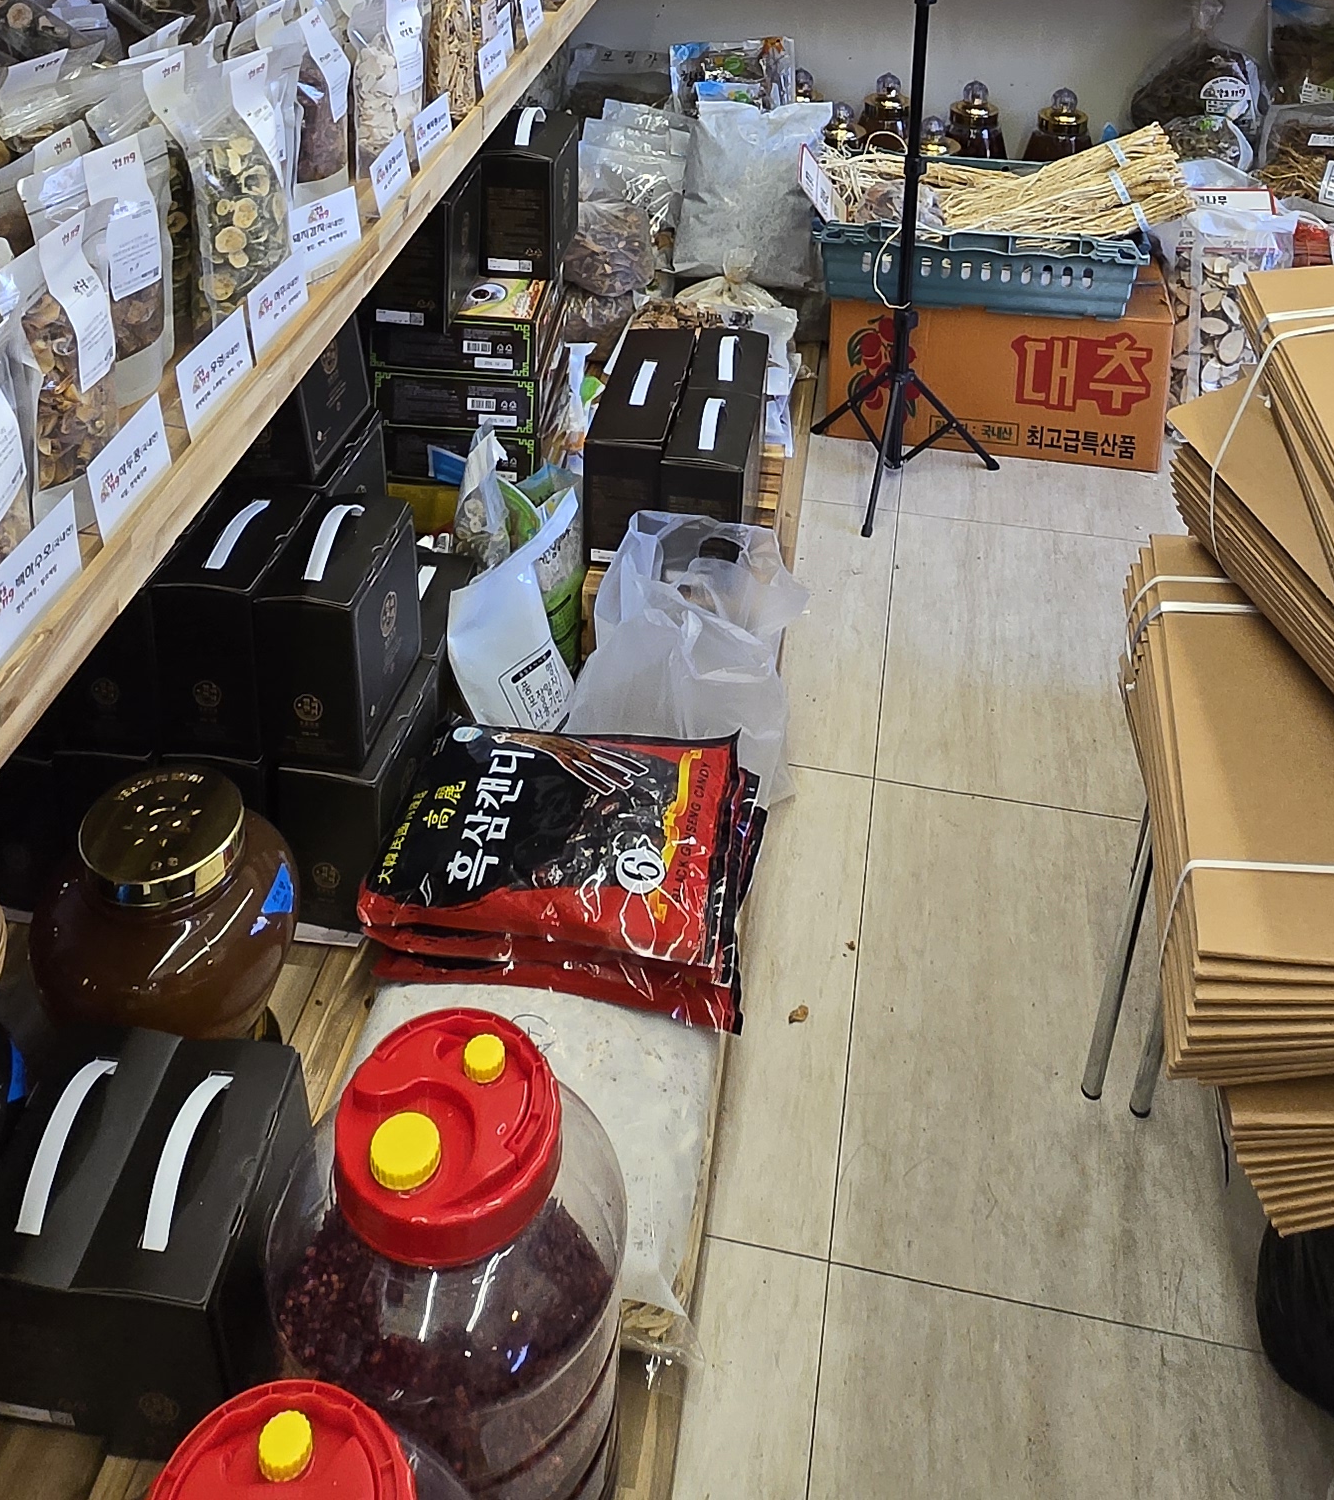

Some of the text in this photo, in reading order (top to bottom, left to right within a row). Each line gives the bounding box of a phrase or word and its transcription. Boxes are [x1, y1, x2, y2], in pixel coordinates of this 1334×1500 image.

[1023, 338, 1148, 409] 대추
[981, 424, 1013, 441] 국내산
[1026, 425, 1136, 460] 최고급특산품
[694, 762, 711, 797] CANDY
[422, 780, 466, 830] 高麗
[446, 749, 535, 891] 흑삼캔디
